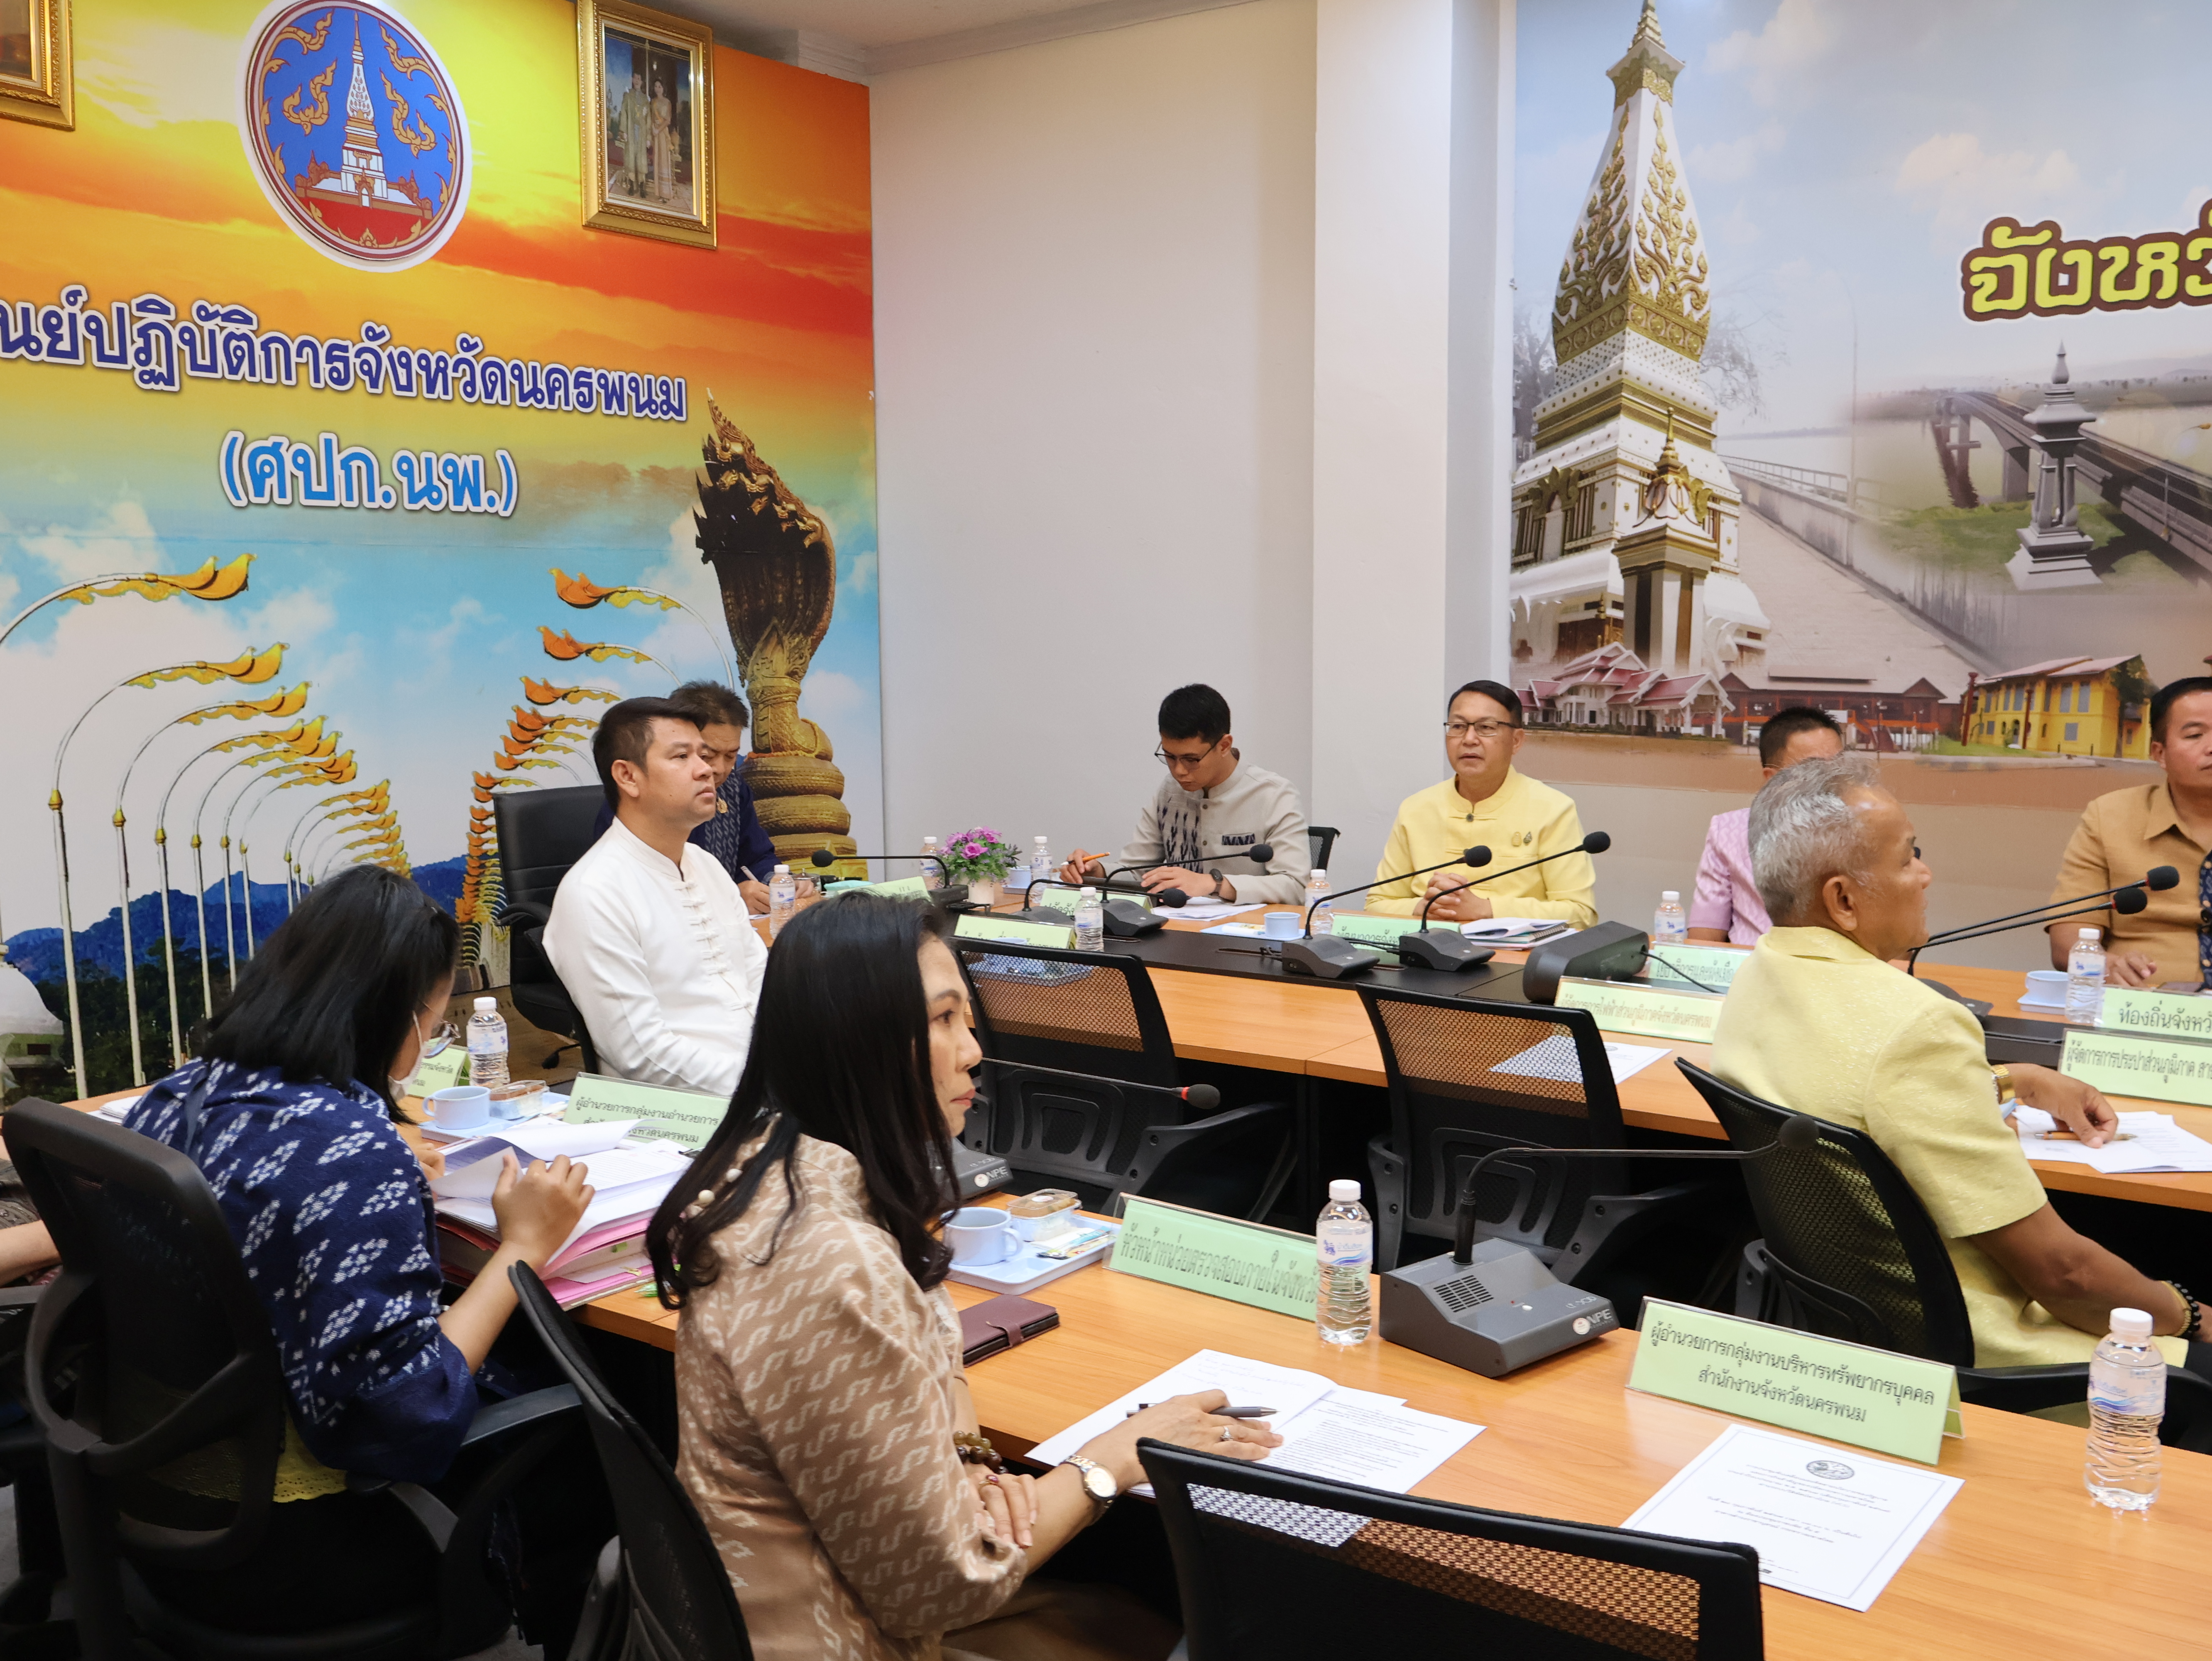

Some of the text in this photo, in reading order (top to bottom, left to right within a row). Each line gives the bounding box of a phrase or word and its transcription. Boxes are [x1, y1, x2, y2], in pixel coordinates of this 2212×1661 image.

[223, 431, 518, 516] (ศปก.นพ.)
[1650, 1320, 1935, 1406] ผู้อำนวยการกลุ่มงานบริหารทรัพยากรบุคคล
[1698, 1365, 1867, 1423] สำนักงานจังหวัดนครพนม
